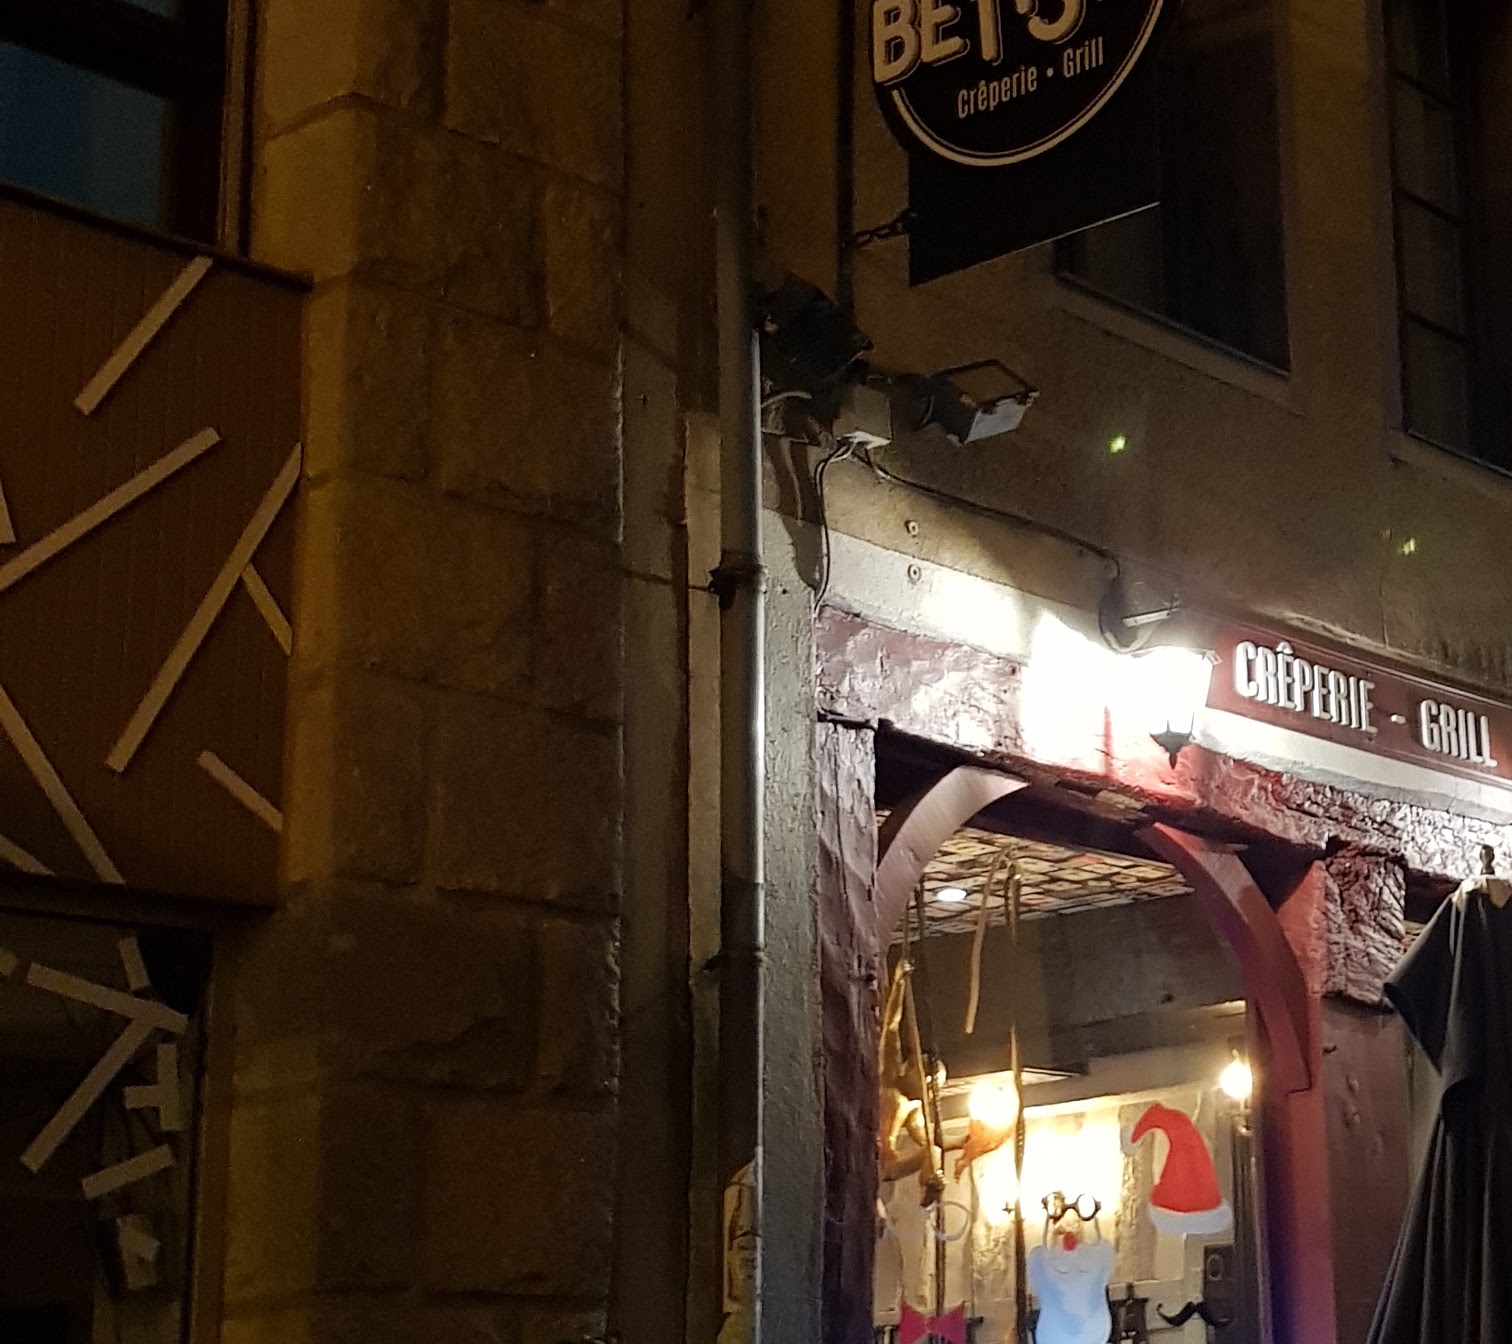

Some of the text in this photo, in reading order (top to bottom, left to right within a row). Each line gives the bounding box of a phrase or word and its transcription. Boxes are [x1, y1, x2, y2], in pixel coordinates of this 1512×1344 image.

[956, 35, 1105, 120] Crêperie Grill
[1234, 640, 1379, 735] CRÊPERIE
[1419, 698, 1499, 768] GRILL
